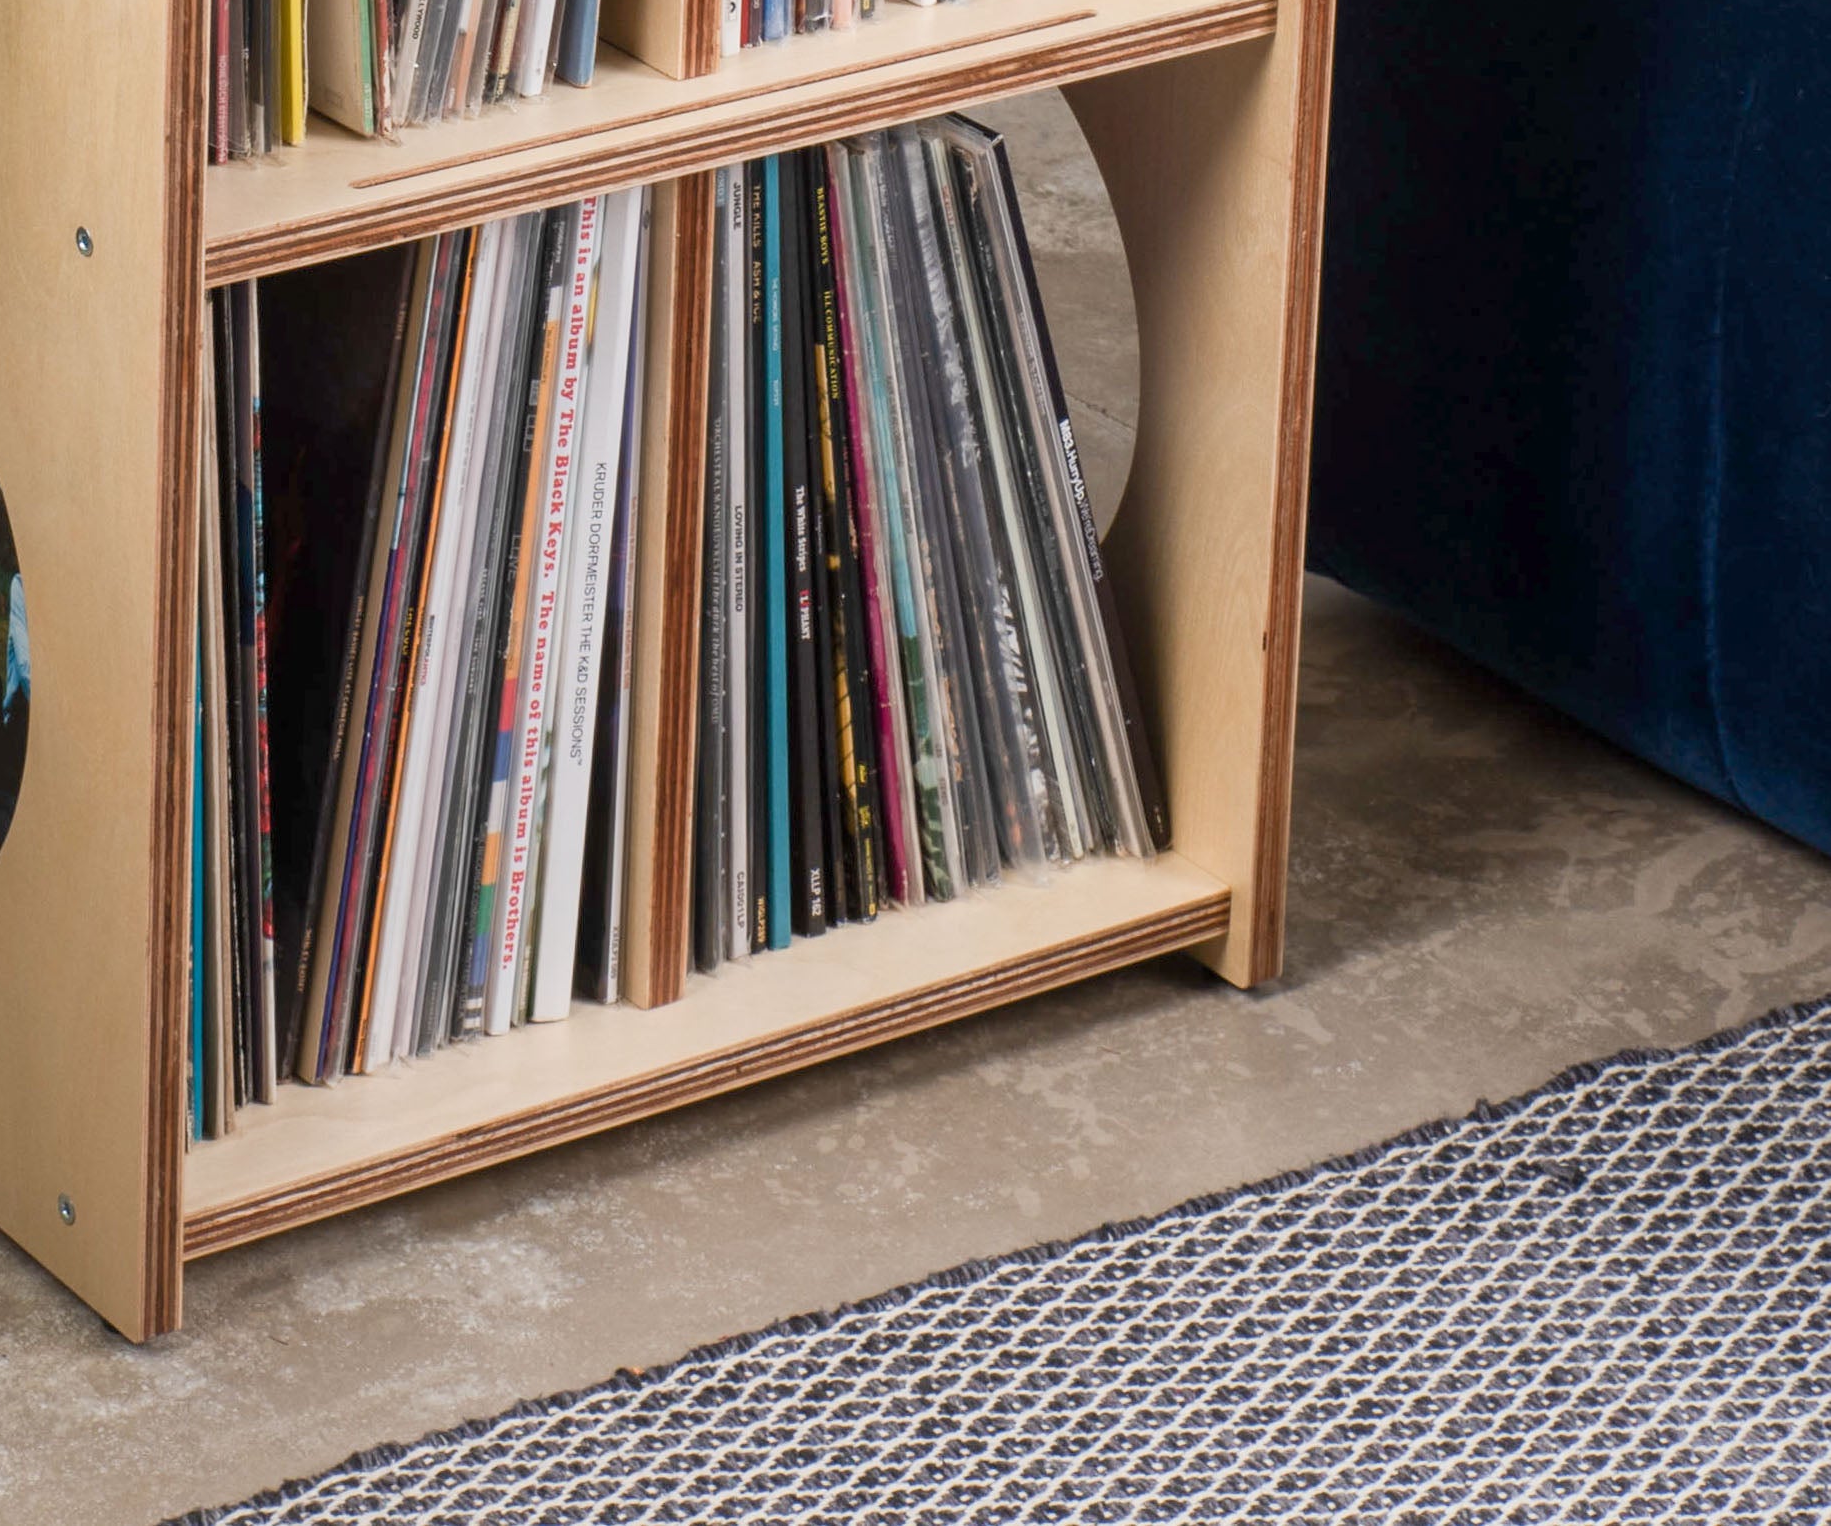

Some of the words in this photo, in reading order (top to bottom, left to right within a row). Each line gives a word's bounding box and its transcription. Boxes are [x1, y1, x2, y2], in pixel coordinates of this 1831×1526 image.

[733, 181, 744, 231] JUNGLE
[753, 184, 762, 209] THE
[816, 187, 828, 234] BEASTIE
[580, 195, 598, 240] This
[753, 212, 762, 248] KILLS
[576, 248, 592, 264] is
[820, 235, 830, 265] BOYS
[573, 272, 587, 297] an
[753, 260, 762, 287] ASH
[753, 302, 762, 325] ICE
[824, 289, 834, 304] ILL
[565, 303, 587, 370] album
[825, 305, 841, 400] COMMUNICATION
[560, 377, 579, 402] by
[557, 409, 576, 448] The
[548, 455, 570, 515] Black
[589, 462, 607, 520] KRUDER
[795, 484, 806, 505] The
[734, 504, 744, 548] LOVING
[796, 505, 808, 537] White
[543, 521, 564, 578] Keys.
[734, 551, 744, 565] IN
[795, 537, 809, 572] Stripes
[579, 523, 602, 623] DORFMEISTER
[734, 566, 744, 612] STEREO
[538, 591, 558, 630] The
[577, 625, 590, 652] THE
[531, 636, 547, 692] name
[574, 654, 589, 684] K&D
[527, 699, 543, 720] of
[522, 727, 540, 768] this
[515, 775, 536, 840] album
[513, 846, 529, 865] is
[810, 867, 821, 895] XLLP
[501, 870, 526, 970] Brothers.
[812, 897, 822, 917] 162
